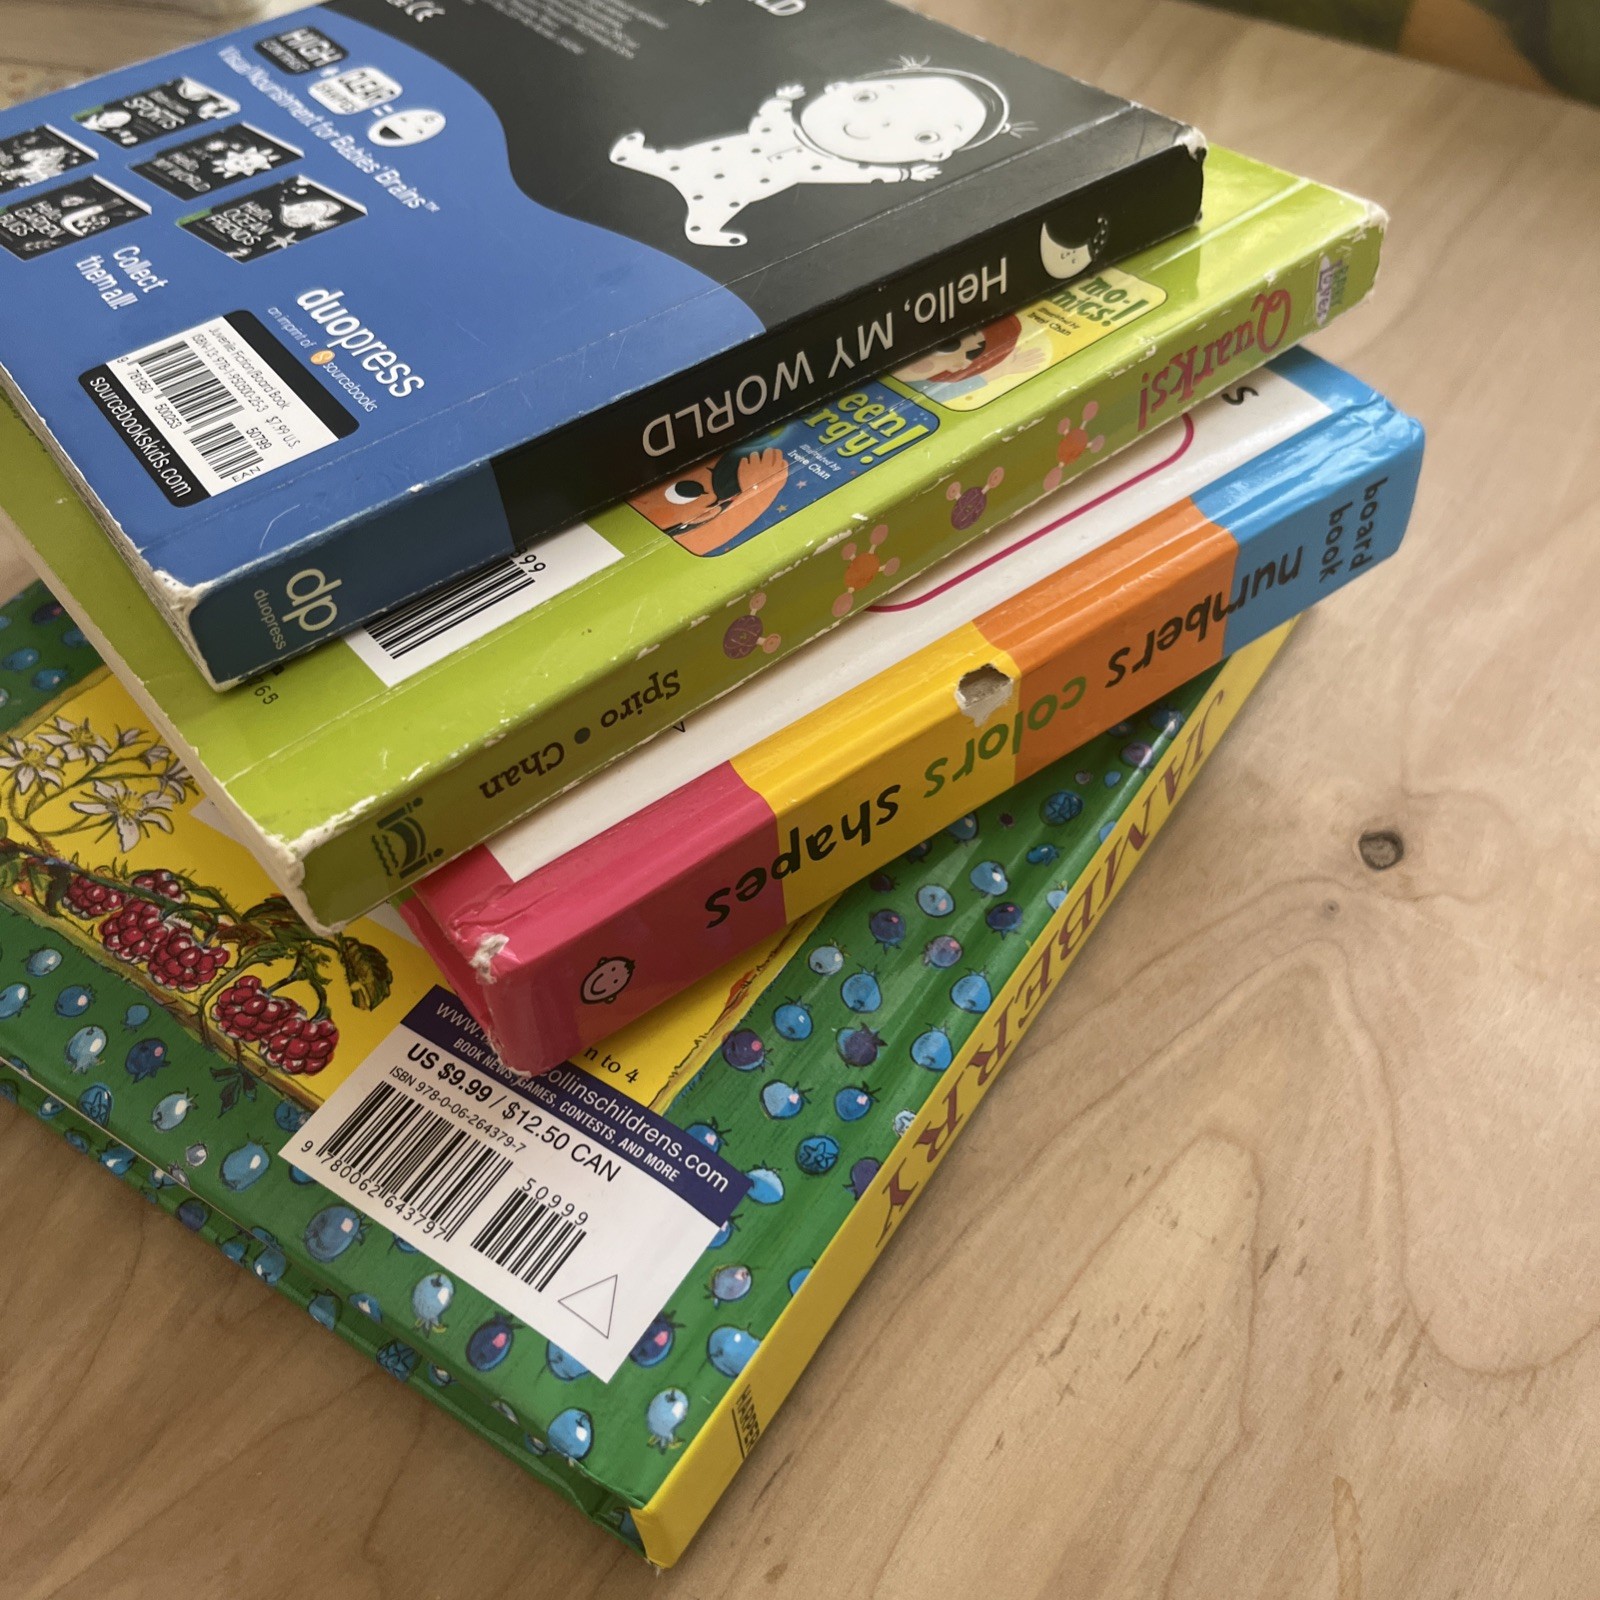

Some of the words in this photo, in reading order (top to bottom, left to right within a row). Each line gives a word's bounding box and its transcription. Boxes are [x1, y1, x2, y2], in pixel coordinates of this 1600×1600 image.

[76, 255, 118, 292] them
[101, 289, 139, 310] all!
[113, 246, 168, 293] Collect
[903, 257, 1008, 327] Hello,
[297, 289, 425, 397] duopress
[300, 338, 317, 349] of
[828, 312, 893, 377] MY
[1138, 288, 1292, 432] Quarks!
[269, 390, 291, 410] Book
[322, 361, 378, 413] sourcebooks
[642, 351, 813, 458] WORLD
[90, 376, 192, 498] sourcebookskids.com
[246, 426, 272, 450] 50799
[231, 466, 261, 483] EAN
[808, 462, 831, 480] Chan
[1318, 502, 1353, 584] book
[1349, 477, 1389, 574] board
[253, 589, 286, 650] duopress
[1104, 545, 1303, 689] numbers
[600, 669, 681, 728] Spiro
[923, 676, 1087, 799] colors
[479, 742, 565, 799] Chan
[704, 784, 901, 930] shapes
[876, 689, 1224, 1248] JAMBERRY
[601, 1054, 621, 1073] to
[625, 1068, 640, 1084] 4
[389, 1065, 418, 1087] ISBN
[415, 1082, 527, 1154] 978-0-06-264379-7
[407, 1043, 439, 1070] US
[438, 1062, 493, 1104] $9.99
[502, 1102, 570, 1151] $12.50
[571, 1144, 622, 1182] CAN
[453, 1037, 482, 1061] BOOK
[559, 1101, 616, 1144] CONTESTS,
[618, 1137, 645, 1158] AND
[643, 1151, 680, 1182] MORE
[301, 1140, 314, 1153] 9
[522, 1178, 589, 1226] 50999
